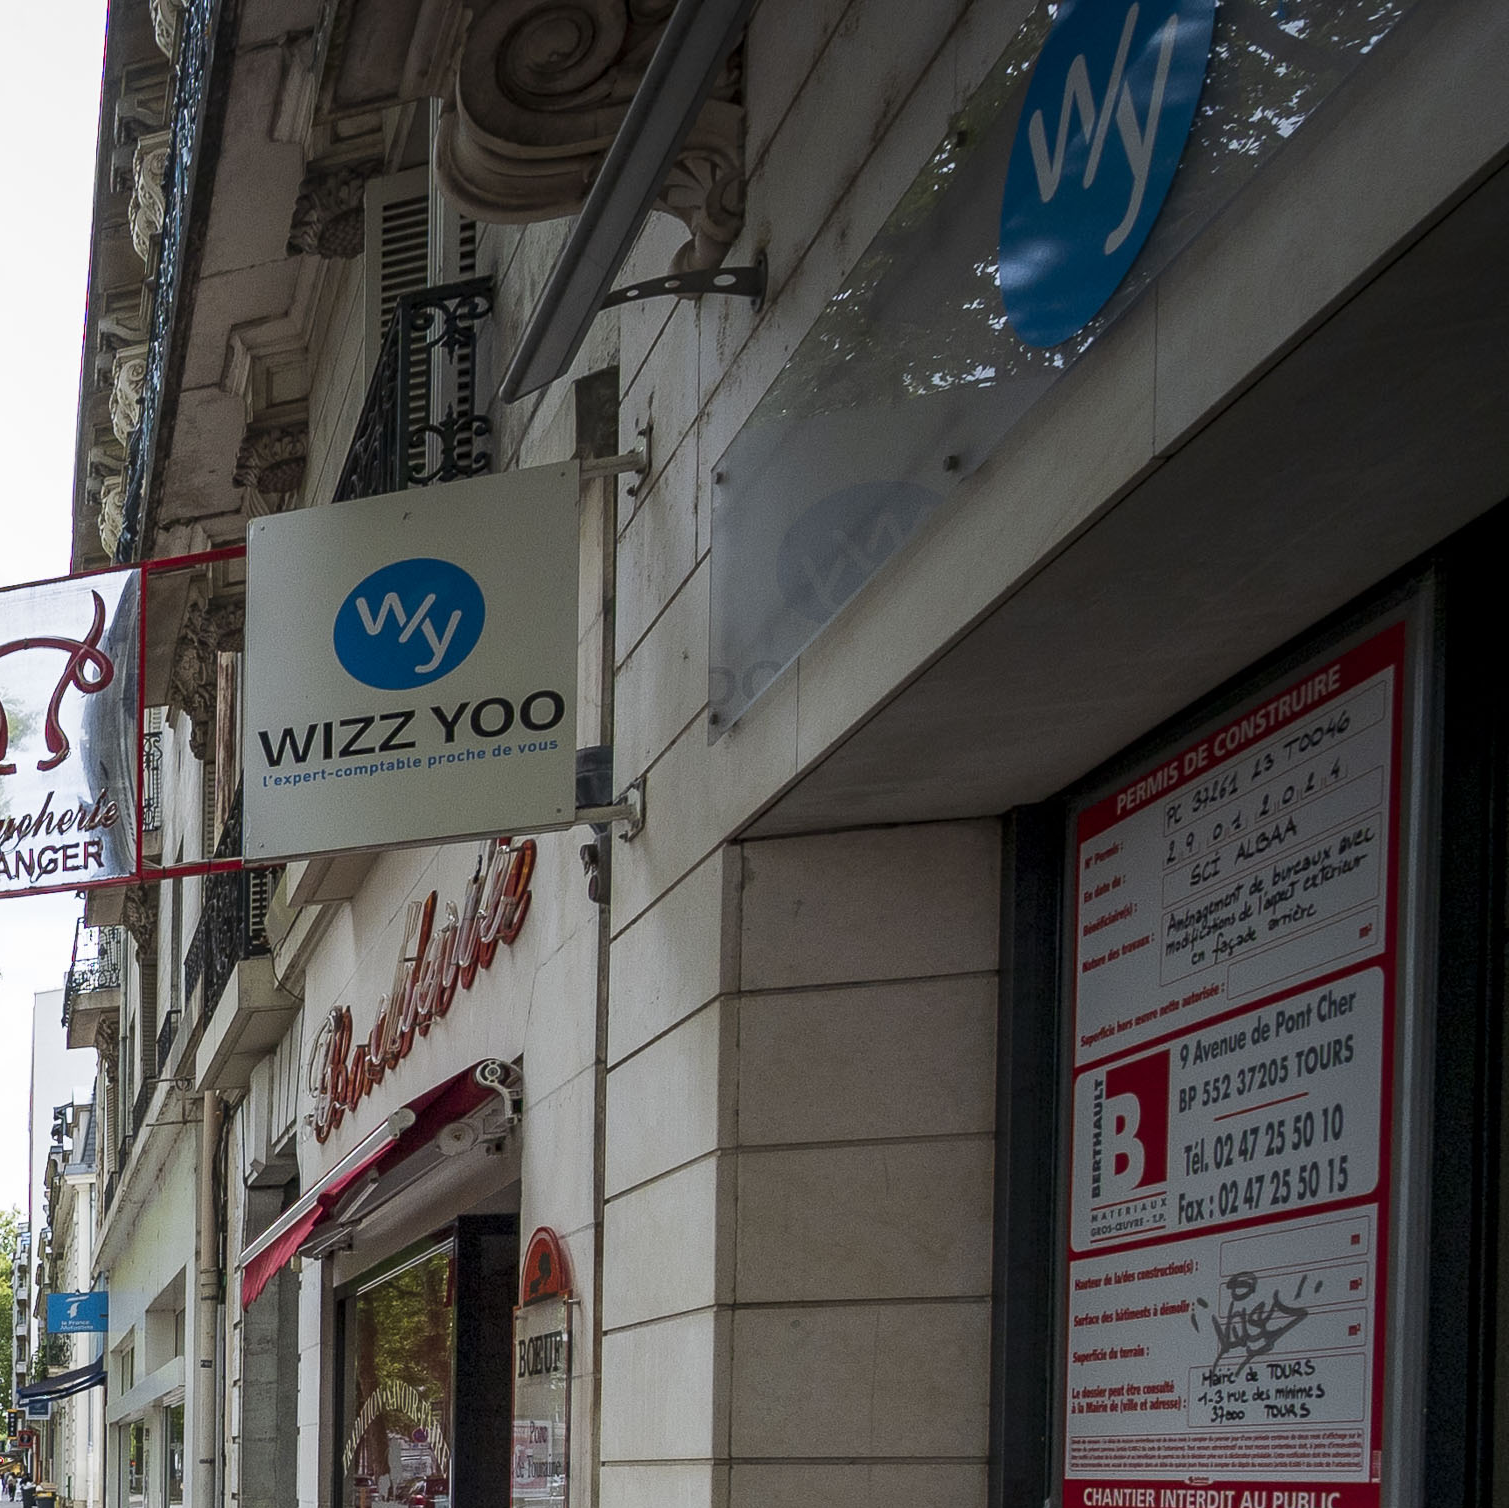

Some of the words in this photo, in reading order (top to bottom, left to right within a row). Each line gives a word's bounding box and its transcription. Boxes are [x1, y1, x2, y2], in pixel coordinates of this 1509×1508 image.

[257, 709, 417, 769] WIZZ
[430, 689, 566, 745] YOO
[1117, 764, 1178, 815] PERMIS
[1184, 749, 1209, 777] DE
[1215, 663, 1341, 758] CONSTRUIRE
[263, 756, 422, 788] l'expert-comptable
[427, 747, 486, 769] proche
[492, 744, 512, 758] de
[517, 739, 559, 755] vous
[1093, 843, 1119, 865] Permis
[1249, 878, 1264, 895] de
[1272, 848, 1330, 886] bureaux
[1339, 827, 1375, 854] avec
[1238, 903, 1254, 921] de
[1107, 947, 1120, 961] des
[1179, 1044, 1190, 1070] 9
[1193, 1035, 1246, 1067] Avenue
[1251, 1015, 1271, 1045] de
[1275, 1005, 1312, 1037] Pont
[1317, 990, 1356, 1022] Cher
[1179, 1085, 1198, 1113] BP
[1202, 1074, 1231, 1106] 552
[1237, 1056, 1289, 1097] 37205
[1296, 1033, 1354, 1078] TOURS
[1091, 1078, 1104, 1198] BERTHAULT
[1184, 1137, 1209, 1177] Tél.
[1213, 1135, 1234, 1170] 02
[1238, 1126, 1260, 1164] 47
[1265, 1119, 1286, 1157] 25
[1291, 1111, 1314, 1151] 50
[1322, 1103, 1344, 1143] 10
[1178, 1192, 1205, 1226] Fax
[1219, 1179, 1239, 1217] 02
[1243, 1173, 1266, 1211] 47
[1270, 1167, 1291, 1206] 25
[1298, 1161, 1320, 1201] 50
[1327, 1155, 1349, 1194] 15
[1075, 1276, 1101, 1291] Hauteur
[1104, 1274, 1113, 1286] de
[1137, 1259, 1194, 1282] construction(s)
[1073, 1312, 1100, 1327] Surface
[1101, 1310, 1114, 1324] des
[1073, 1349, 1108, 1364] Superficie
[1110, 1347, 1118, 1360] du
[1120, 1345, 1144, 1358] terrain
[1246, 1367, 1259, 1383] de
[1267, 1359, 1316, 1381] TOURS
[1072, 1387, 1080, 1400] Le
[1081, 1385, 1107, 1399] dossier
[1109, 1385, 1125, 1399] peut
[1126, 1382, 1141, 1395] être
[1143, 1379, 1175, 1395] consulté
[1227, 1388, 1248, 1402] rue
[1252, 1385, 1271, 1401] des
[1275, 1380, 1325, 1399] minimes
[1085, 1399, 1108, 1413] Mairie
[1109, 1398, 1118, 1411] de
[1140, 1398, 1148, 1410] et
[1264, 1403, 1311, 1419] TOURS
[1083, 1487, 1156, 1508] CHANTIER
